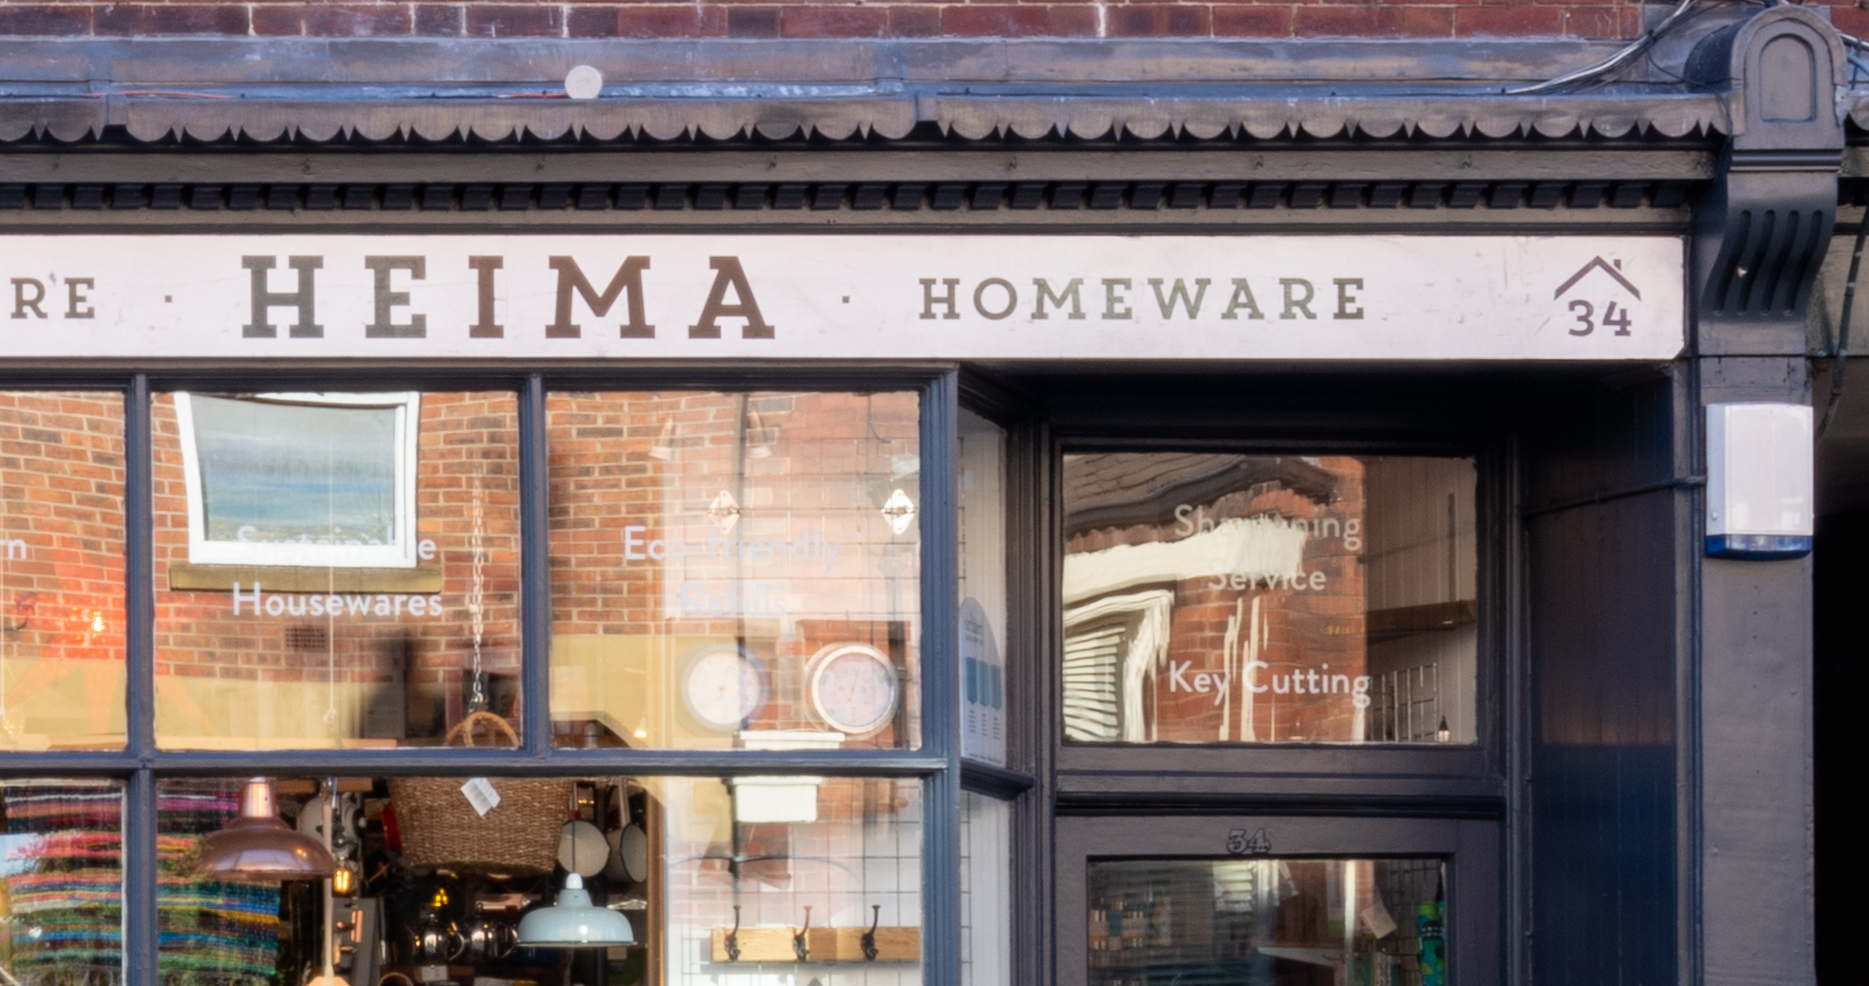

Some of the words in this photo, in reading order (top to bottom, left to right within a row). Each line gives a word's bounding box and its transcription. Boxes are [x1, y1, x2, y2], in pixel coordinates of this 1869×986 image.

[241, 255, 776, 339] HEIMA
[919, 277, 1365, 321] HOMEWARE
[1568, 299, 1633, 337] 34
[233, 581, 443, 616] Housewares
[1169, 660, 1231, 706] Key
[1242, 660, 1371, 708] Cutting
[1226, 828, 1272, 854] 34
